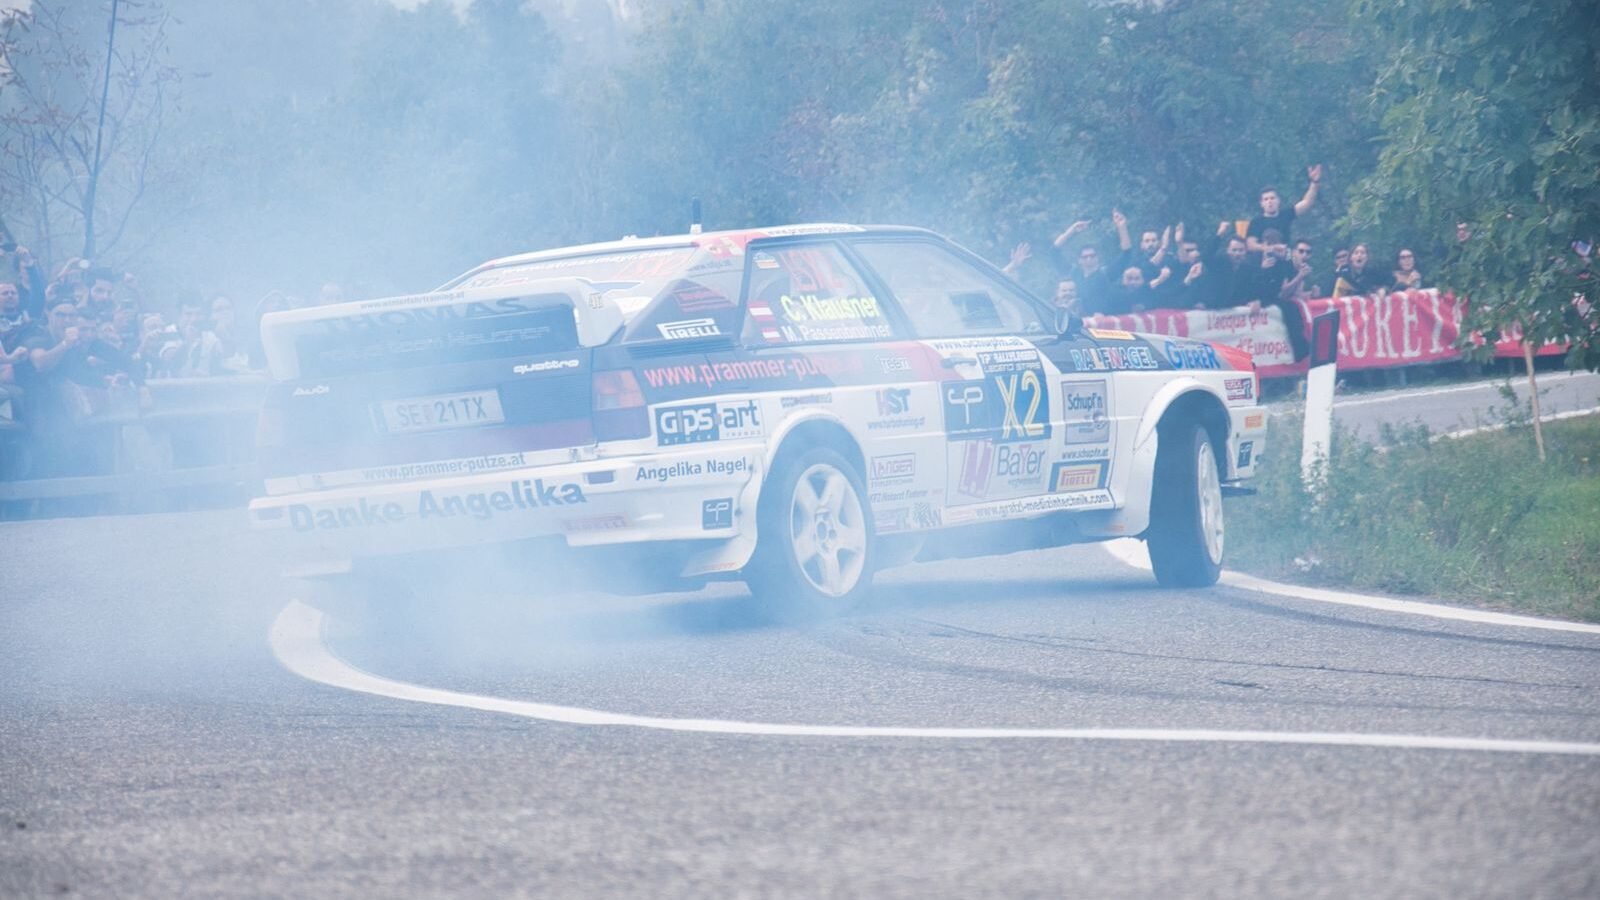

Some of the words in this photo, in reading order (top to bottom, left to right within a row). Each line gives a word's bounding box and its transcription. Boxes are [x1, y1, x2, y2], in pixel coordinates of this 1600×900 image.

[800, 295, 880, 321] Klausner
[656, 317, 722, 339] PIRELLI
[512, 358, 580, 375] quattro
[875, 387, 911, 416] HST
[994, 371, 1045, 438] X2
[396, 403, 422, 429] SE
[360, 453, 528, 481] www.prammer-putze.at
[635, 461, 702, 482] Angelika
[706, 456, 747, 475] Nagel
[288, 497, 404, 532] Danke
[419, 478, 588, 519] Angelika
